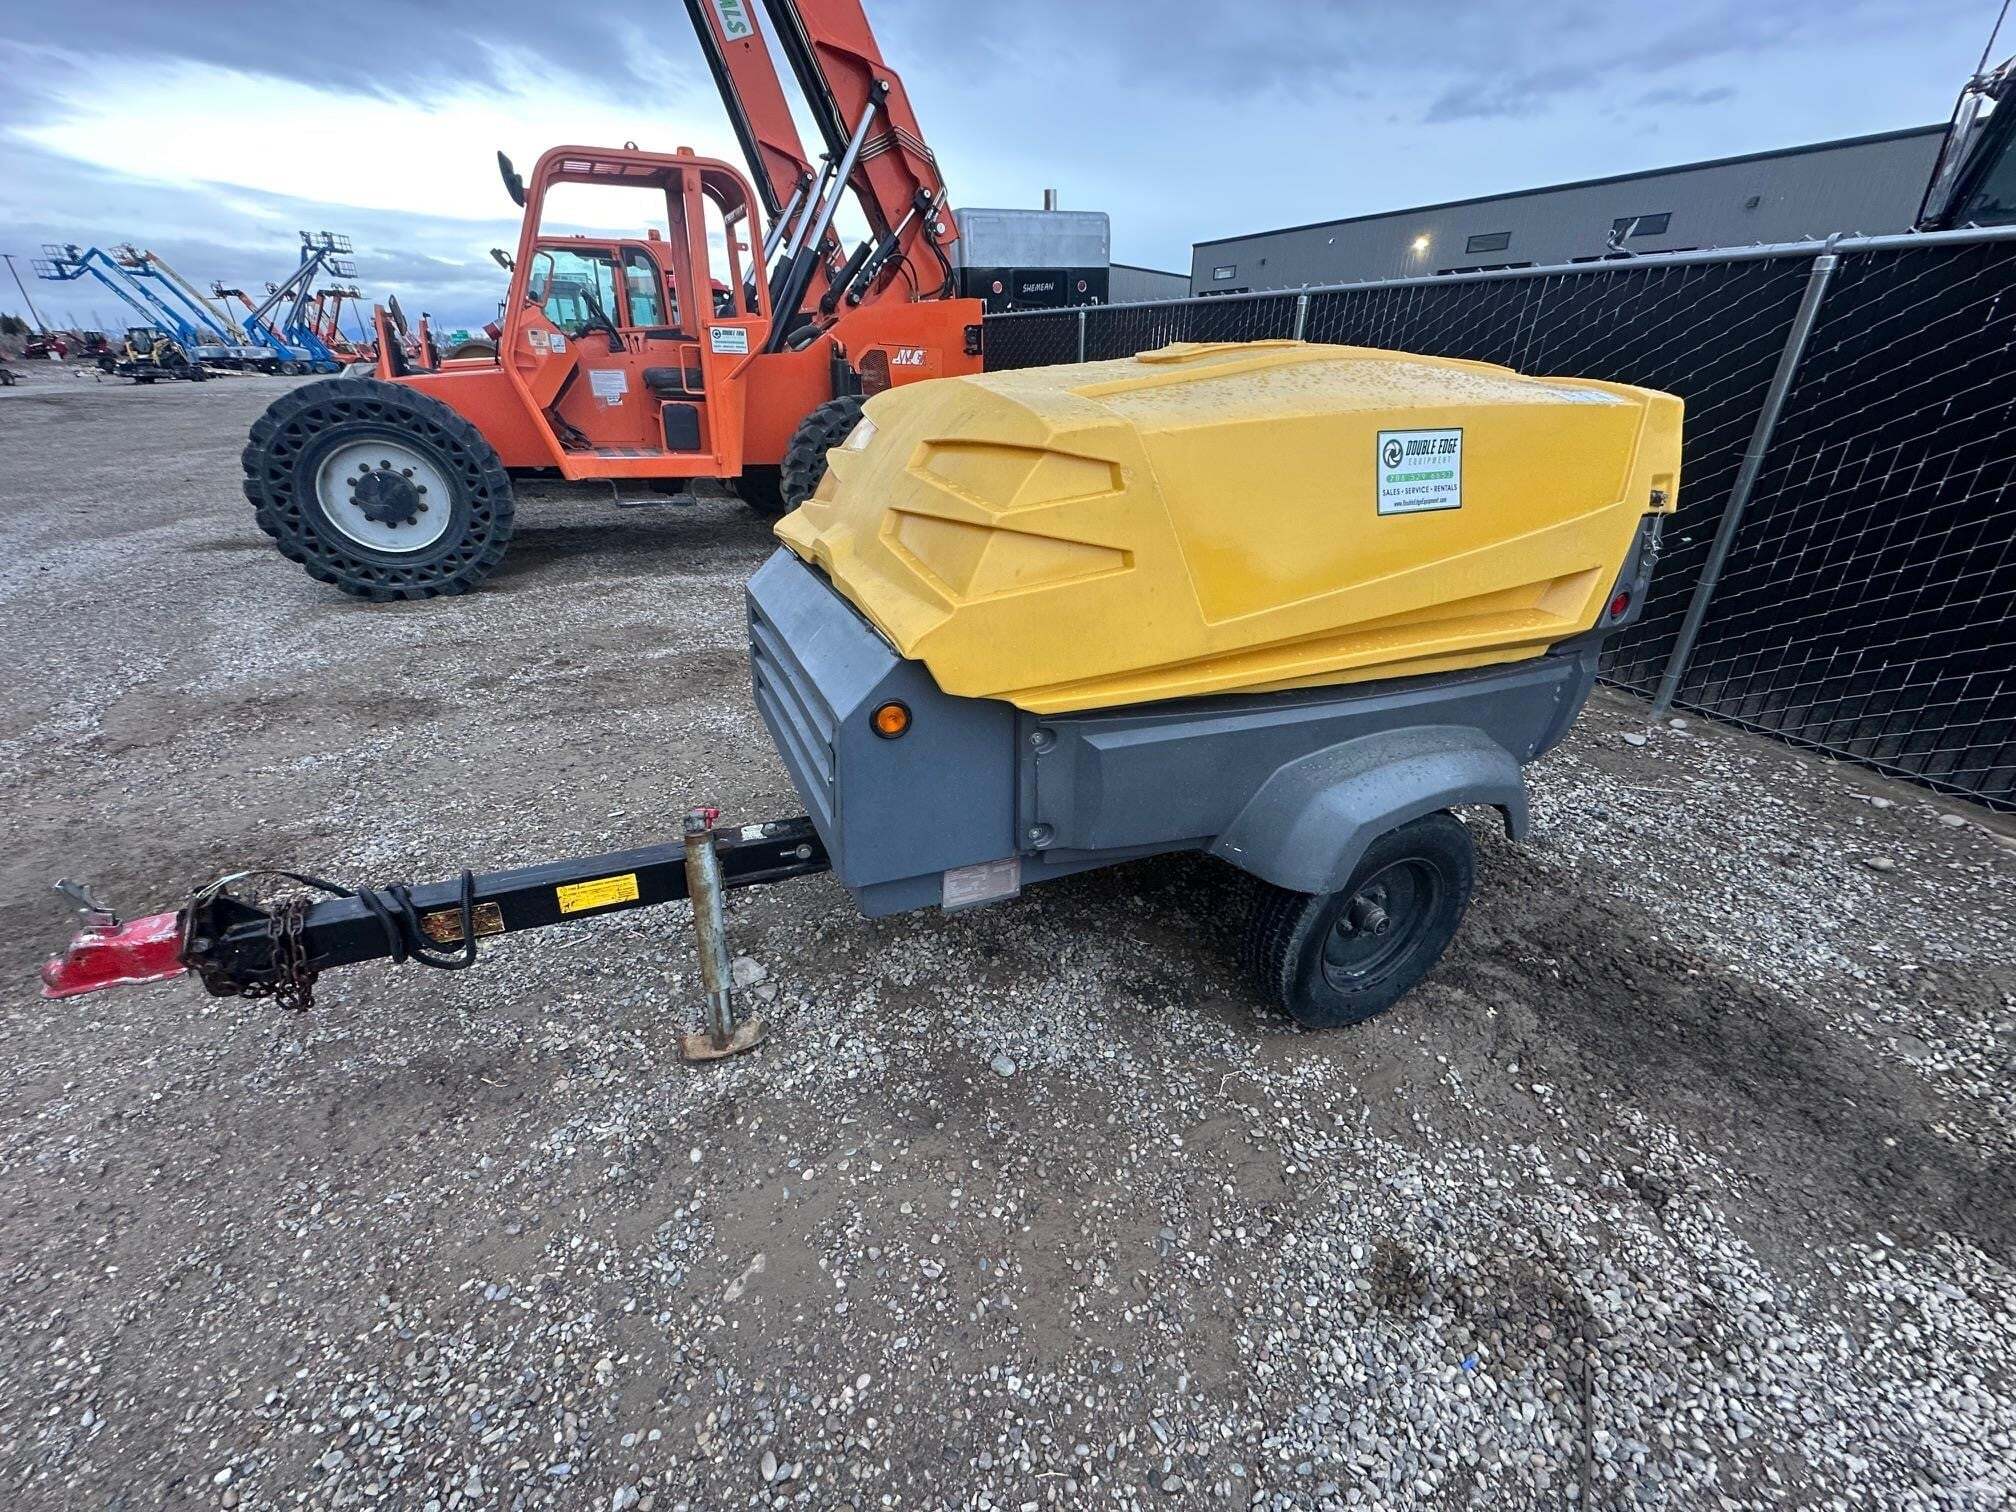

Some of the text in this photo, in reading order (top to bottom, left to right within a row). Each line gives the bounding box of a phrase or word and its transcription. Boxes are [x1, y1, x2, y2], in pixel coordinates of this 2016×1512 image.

[1405, 438, 1458, 456] DOUBLE EDGE
[1382, 484, 1458, 497] SALES SERVICE RENTALS
